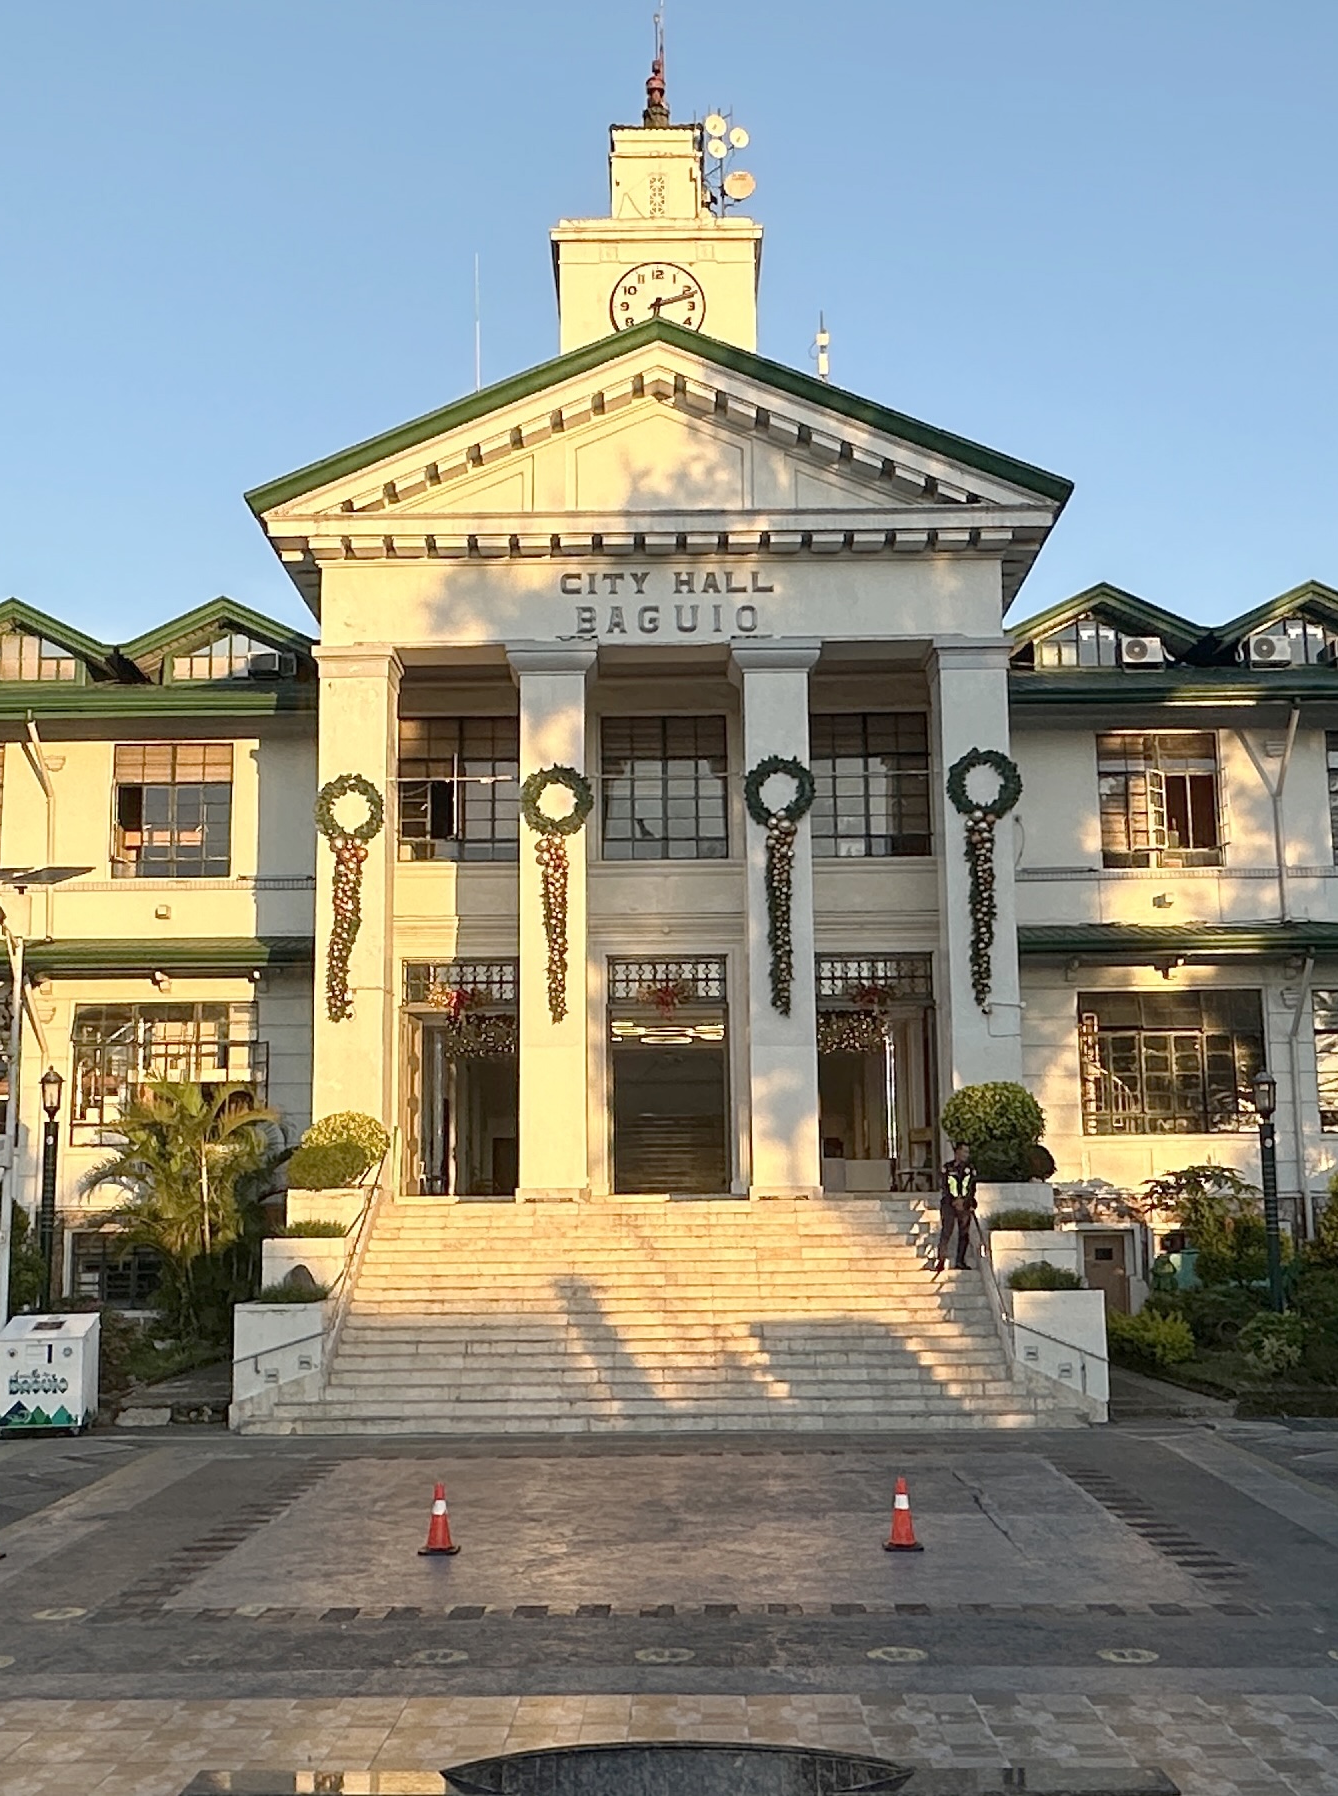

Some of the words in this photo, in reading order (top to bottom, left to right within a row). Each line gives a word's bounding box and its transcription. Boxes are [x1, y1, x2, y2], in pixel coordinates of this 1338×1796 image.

[637, 273, 645, 285] 11
[651, 269, 665, 281] 12
[623, 285, 638, 296] 10
[620, 301, 630, 311] 9
[687, 301, 696, 311] 3
[683, 316, 692, 326] 4
[559, 571, 651, 596] CITY
[673, 570, 775, 595] HALL
[575, 603, 760, 635] BAGUIO
